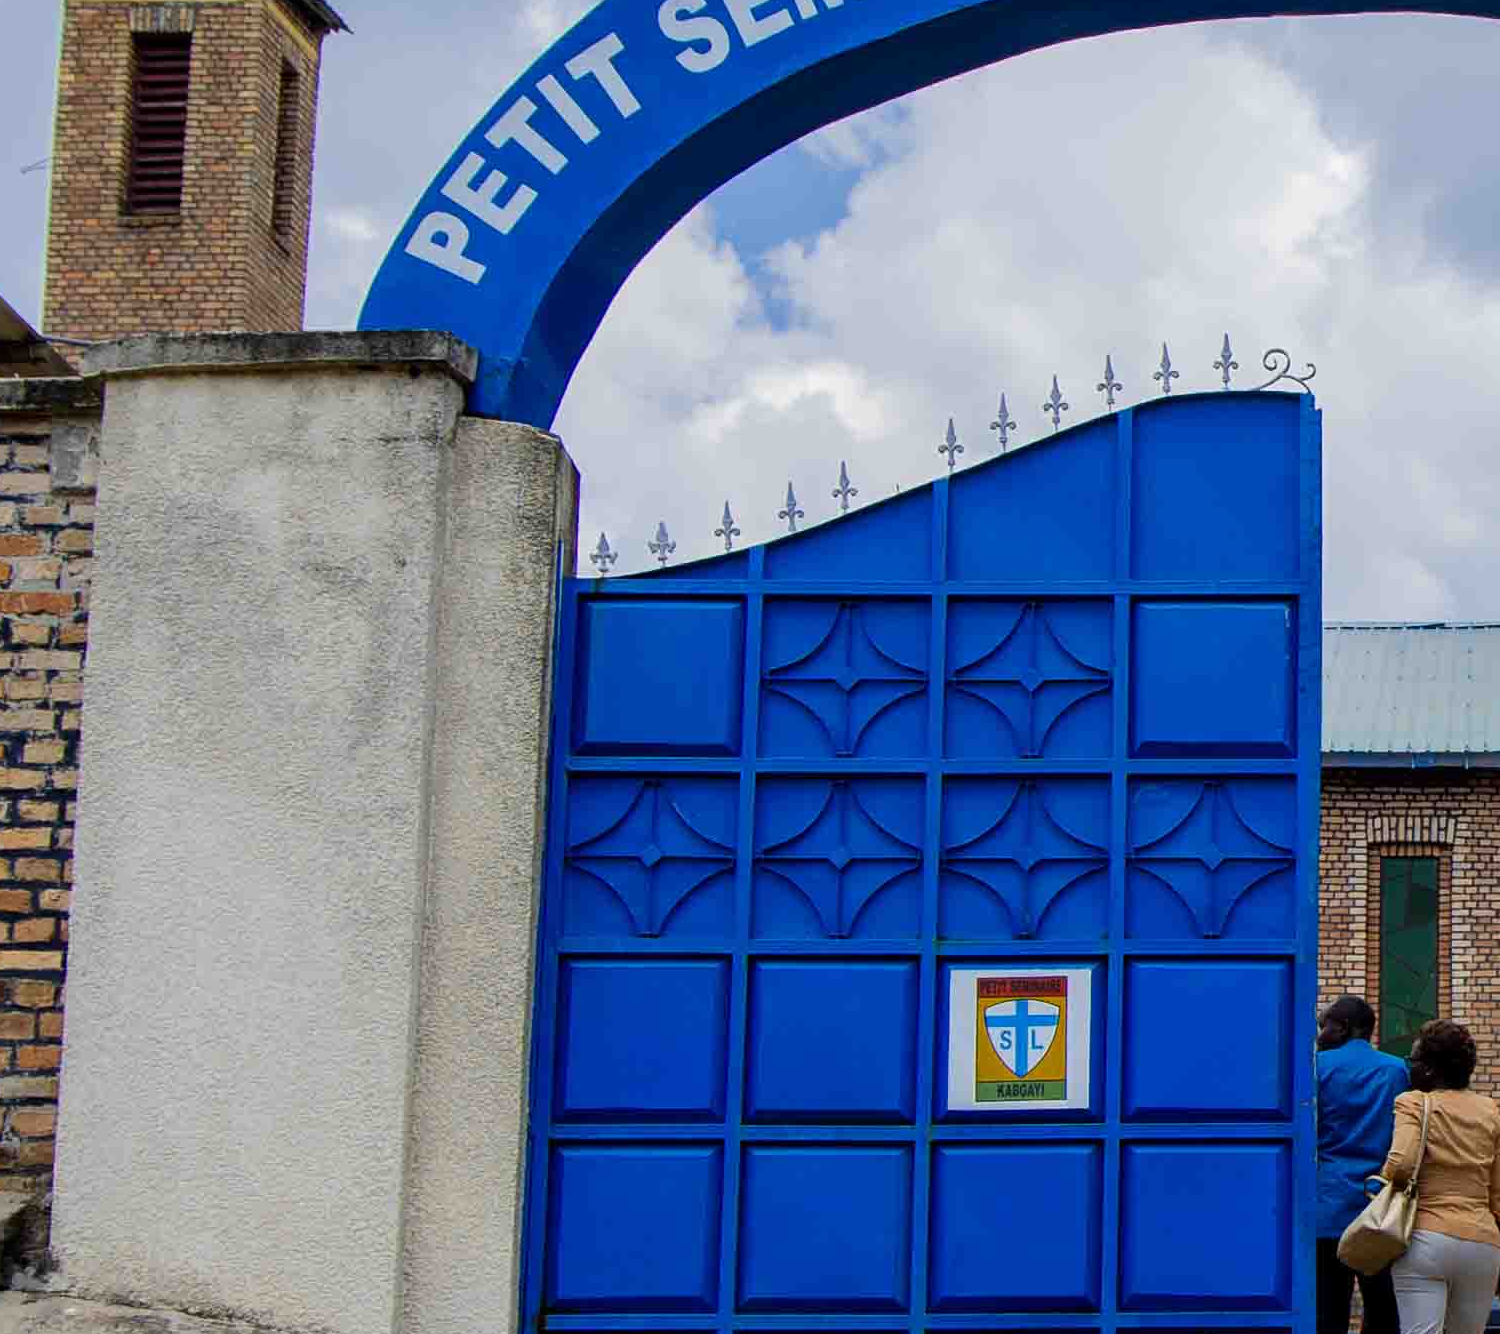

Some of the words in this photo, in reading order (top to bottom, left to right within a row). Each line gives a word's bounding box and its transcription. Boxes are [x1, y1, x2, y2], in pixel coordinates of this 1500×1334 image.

[404, 32, 641, 285] PETIT
[999, 1030, 1012, 1050] S
[1030, 1029, 1044, 1049] L
[996, 1083, 1045, 1099] KABGAYI
